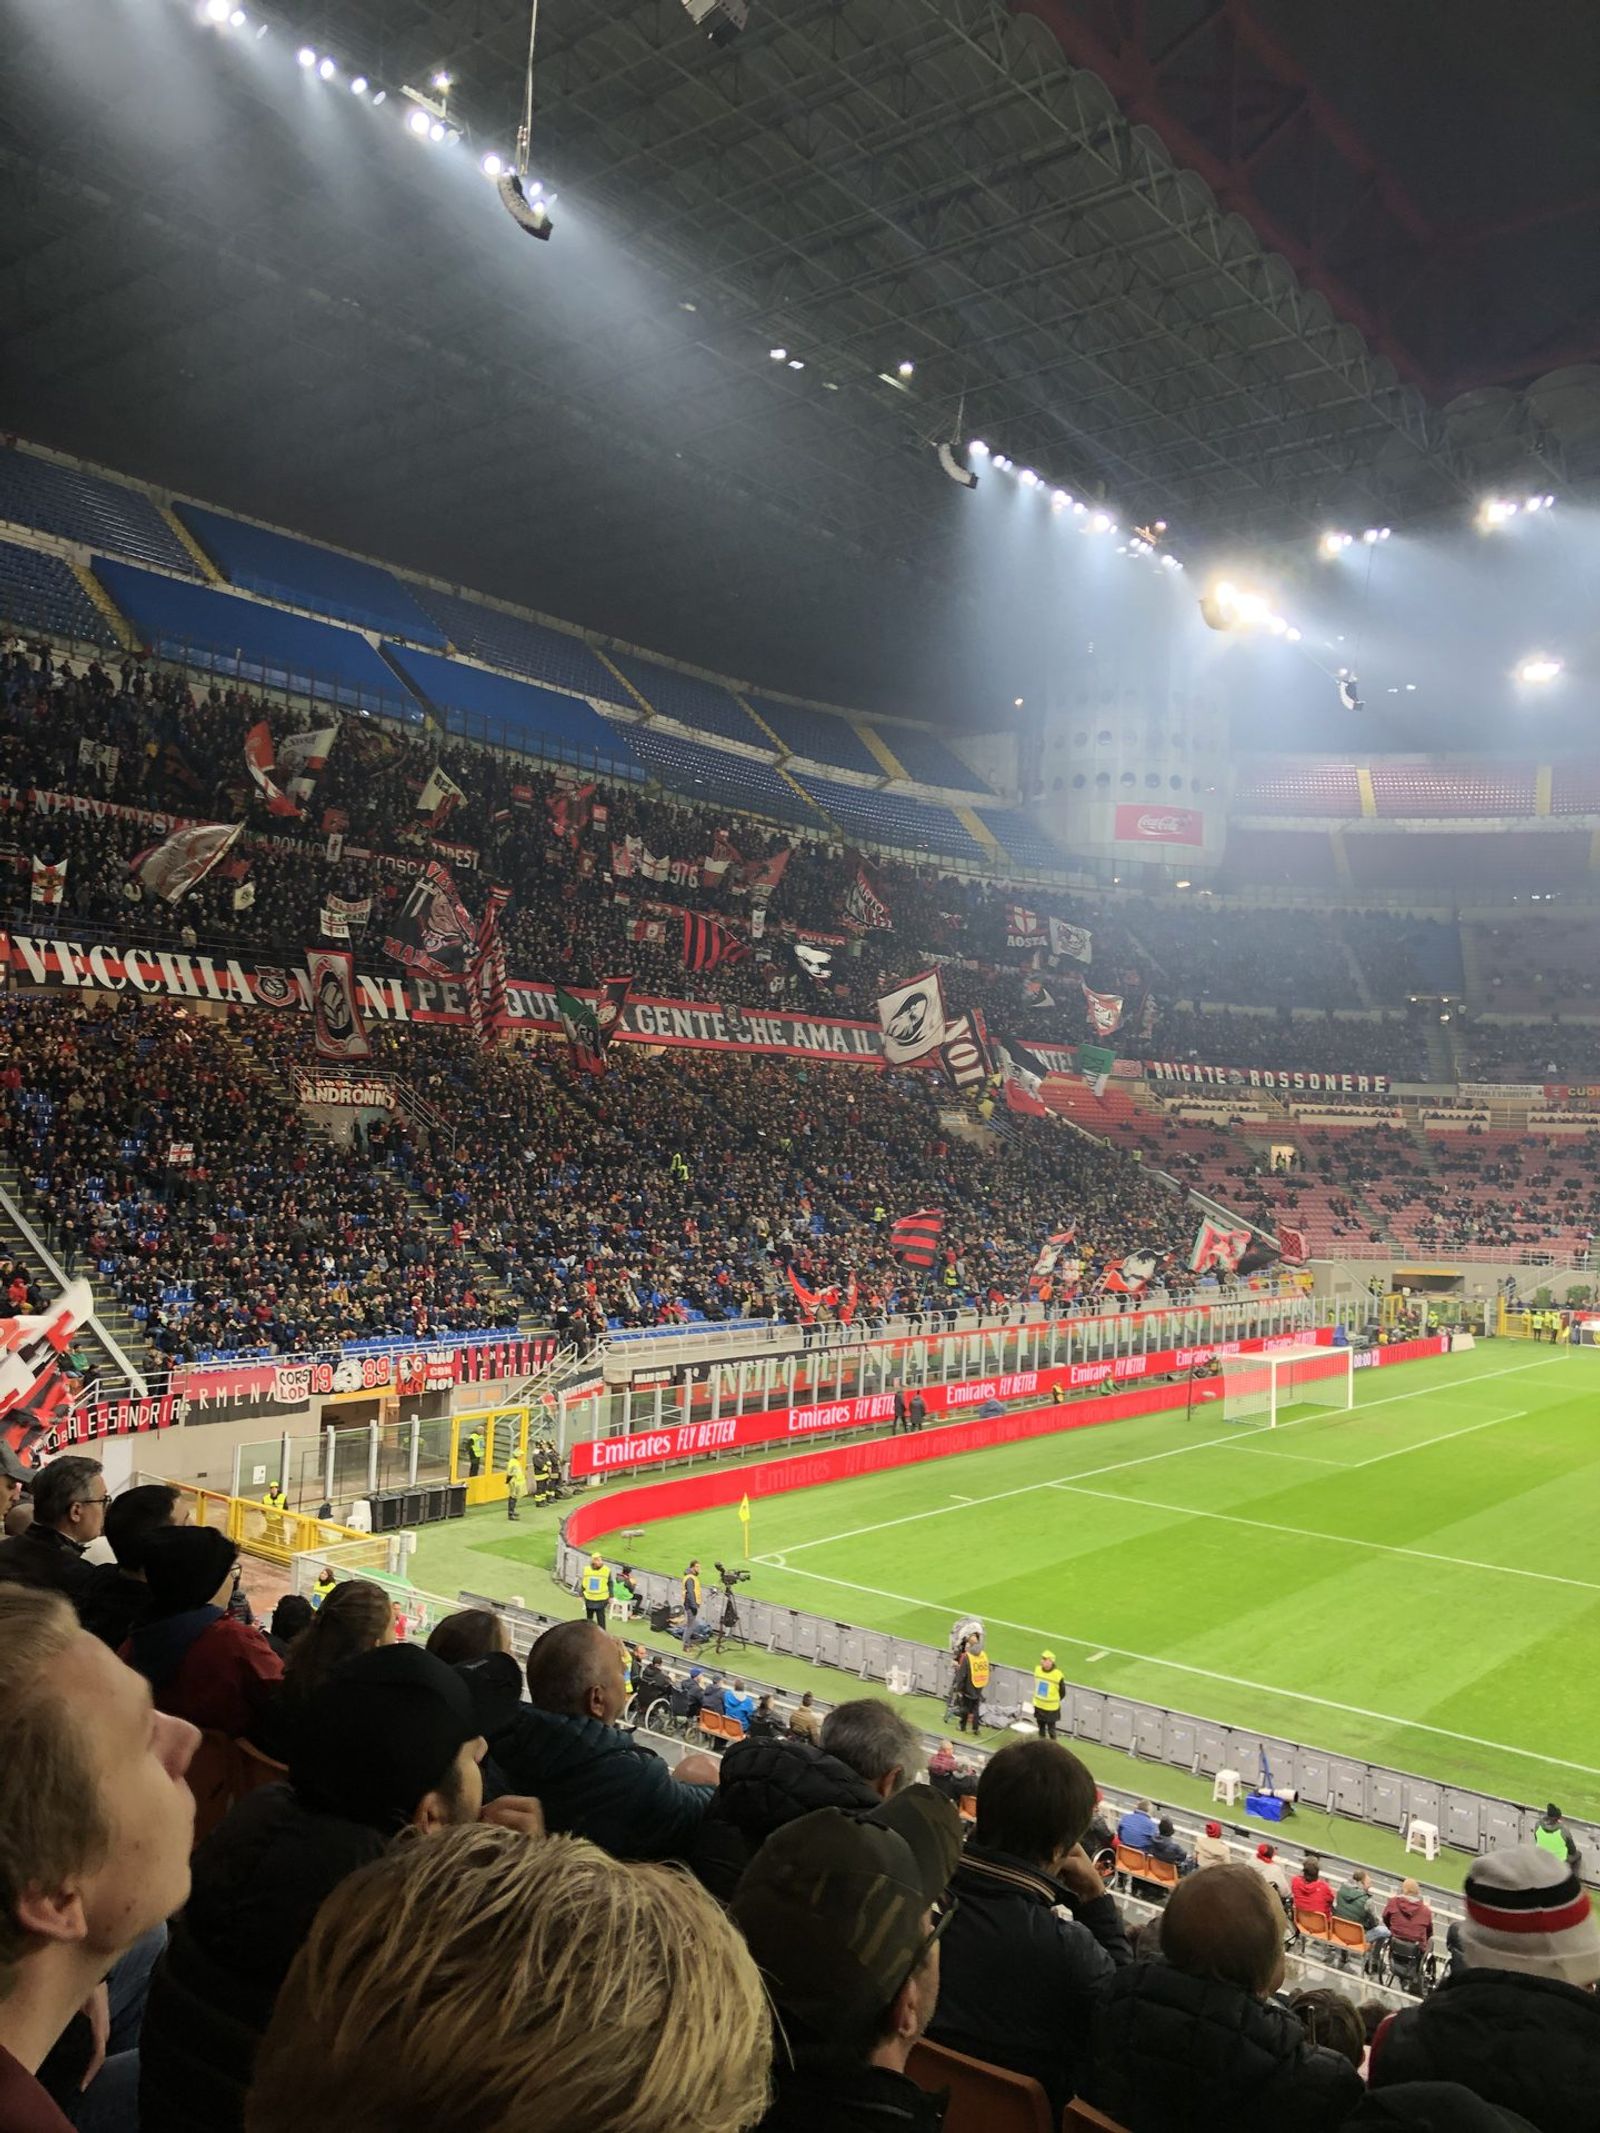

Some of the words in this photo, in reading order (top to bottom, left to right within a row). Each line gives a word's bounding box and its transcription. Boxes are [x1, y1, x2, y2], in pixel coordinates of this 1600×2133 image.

[1007, 934, 1049, 948] AOSTA
[12, 936, 258, 1004] VECCHIA
[635, 1004, 730, 1041] GENTE
[793, 1022, 849, 1054] AMA
[854, 1029, 877, 1055] IL
[1153, 1061, 1226, 1085] BRIGATE
[1250, 1069, 1387, 1093] ROSSONERE
[311, 1363, 333, 1394] 19
[362, 1355, 391, 1389] 89
[413, 1355, 423, 1373] 6
[1071, 1361, 1112, 1384] Emirates
[1115, 1359, 1125, 1377] FLY
[1125, 1356, 1147, 1375] BETTER
[946, 1381, 996, 1405] Emirates
[999, 1378, 1012, 1397] FLY
[1012, 1373, 1038, 1393] BETTER
[68, 1398, 180, 1438] ALESSANDRIA
[788, 1405, 850, 1432] Emirates
[854, 1399, 870, 1420] FLY
[870, 1395, 896, 1418] BETTE
[592, 1434, 671, 1467] Emirates
[676, 1426, 697, 1452] FLY
[697, 1420, 737, 1446] BETTER
